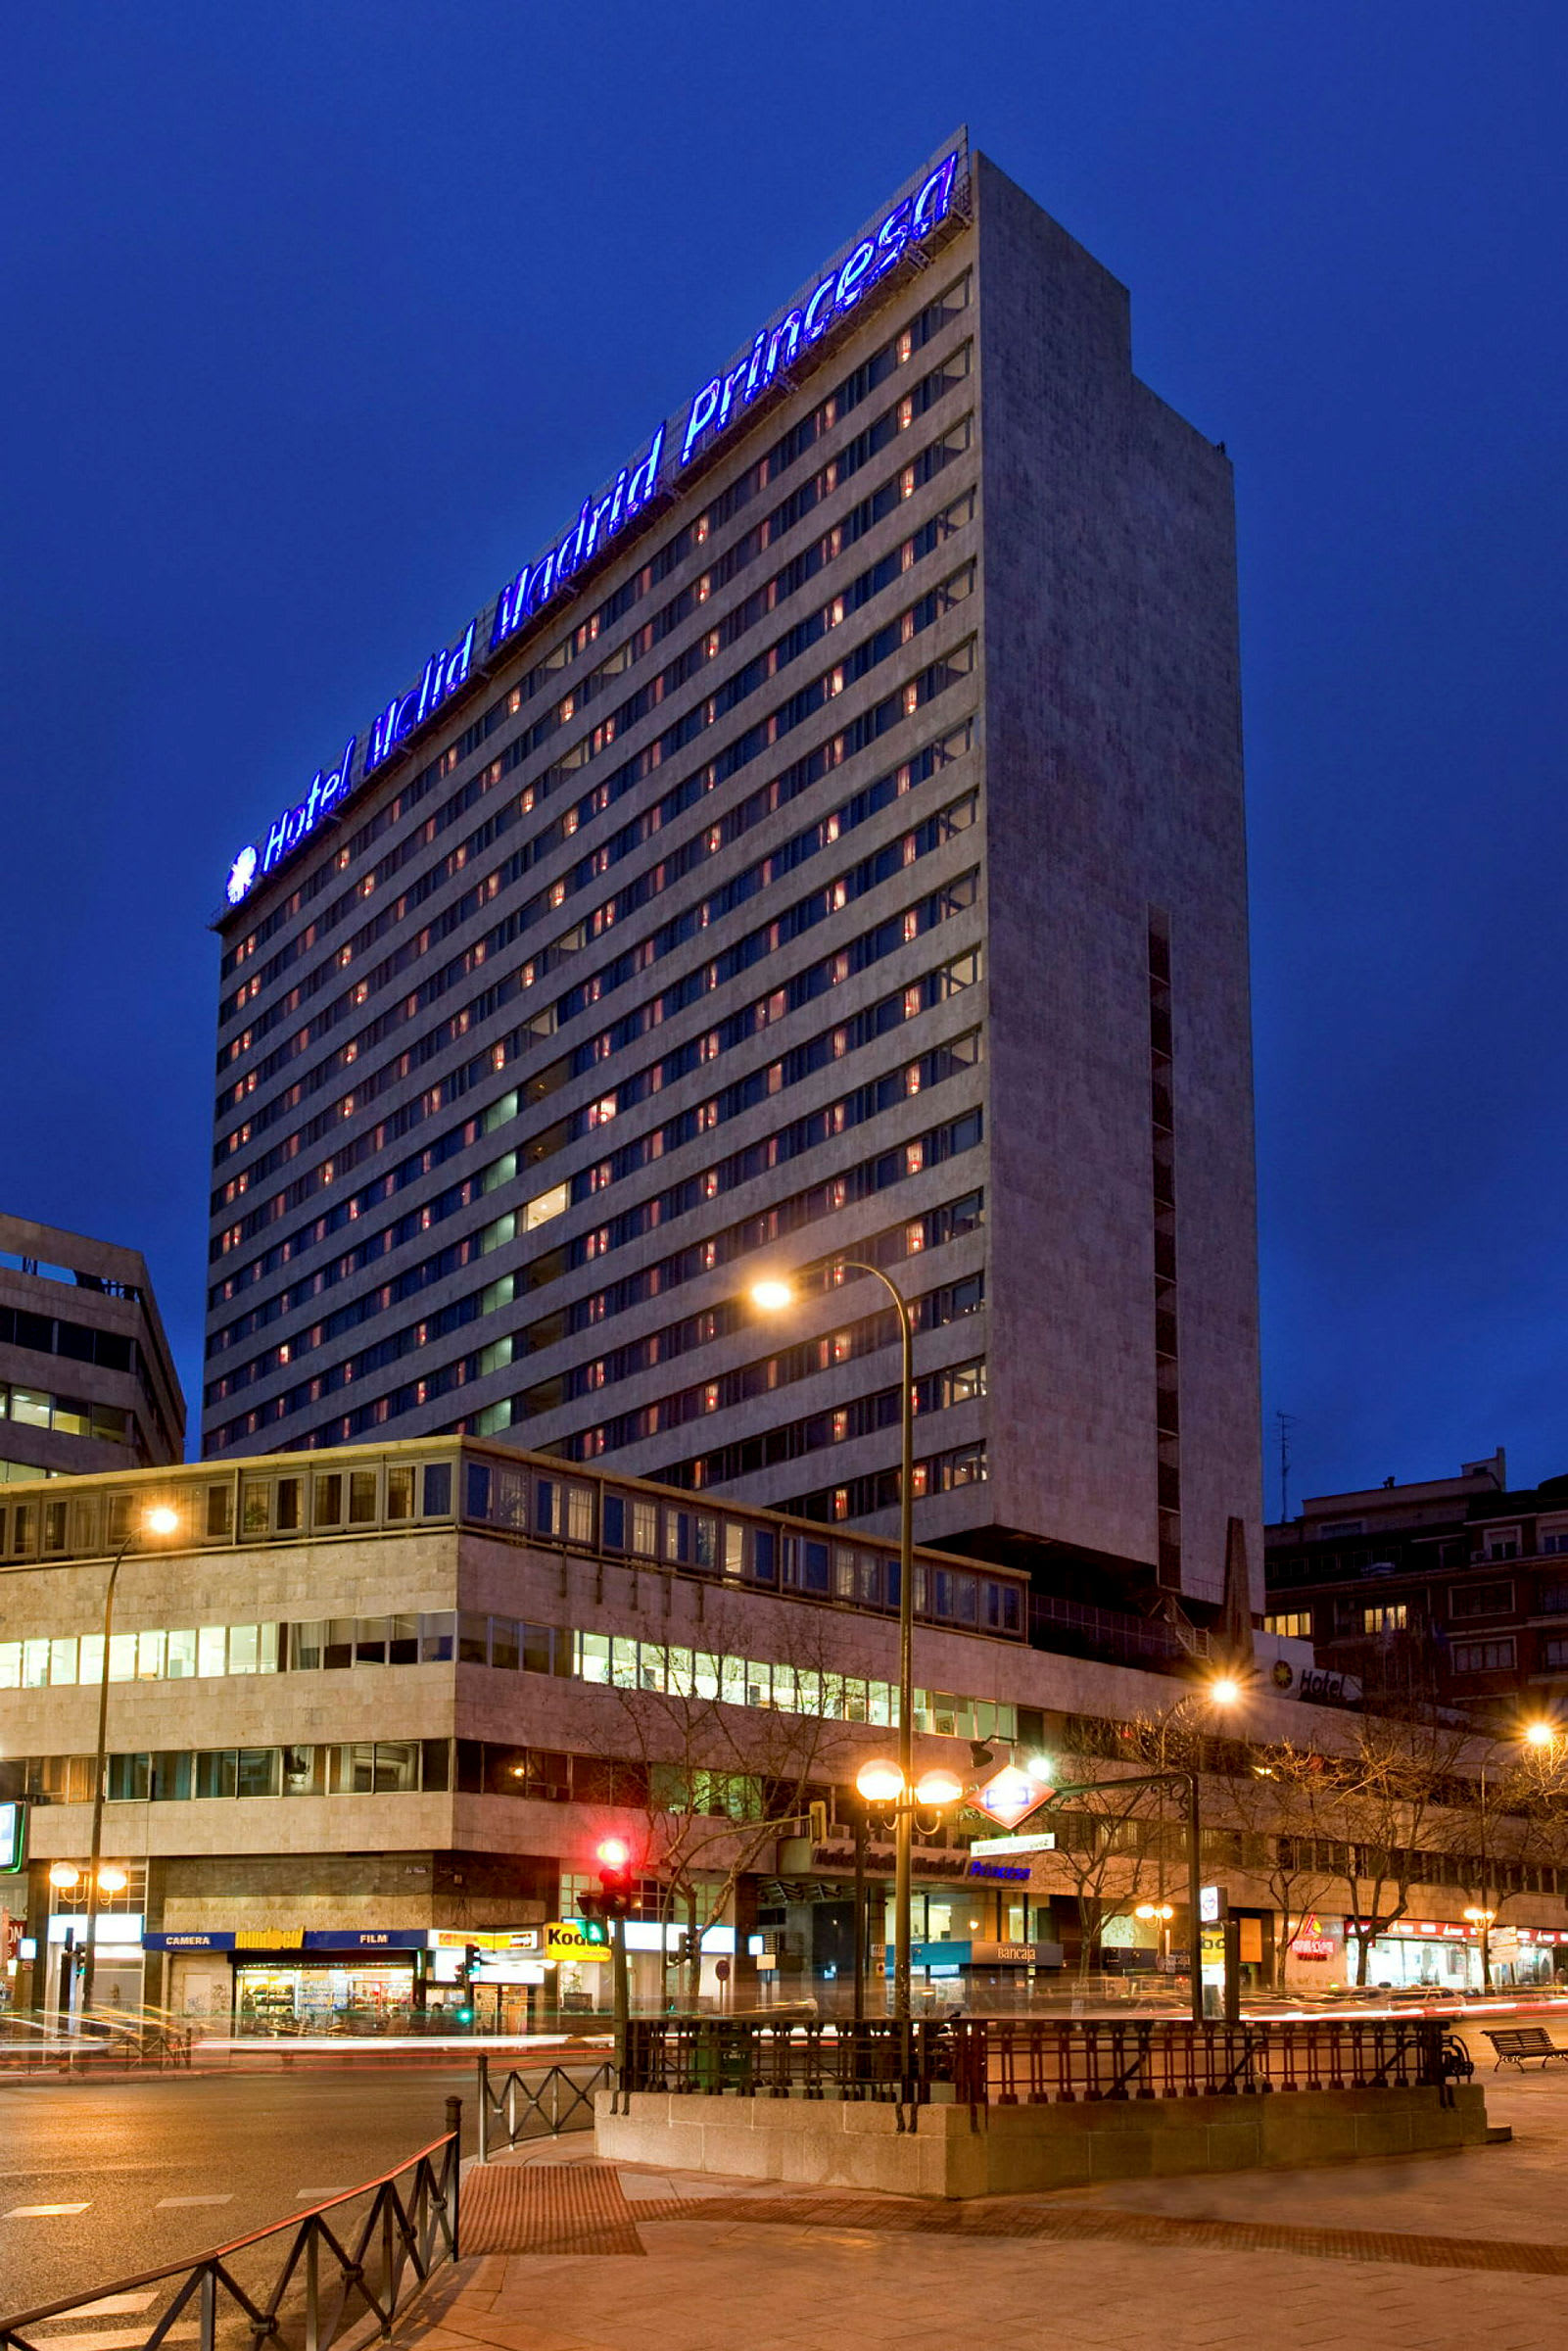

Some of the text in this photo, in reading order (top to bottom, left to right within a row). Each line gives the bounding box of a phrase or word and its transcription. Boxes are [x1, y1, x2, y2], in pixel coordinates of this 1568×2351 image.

[261, 736, 356, 874] Hotel
[490, 419, 666, 654] Madrid
[681, 151, 958, 466] Princesa
[1300, 1669, 1347, 1698] Hotel
[166, 1936, 211, 1946] CAMERA
[359, 1934, 389, 1944] FILM
